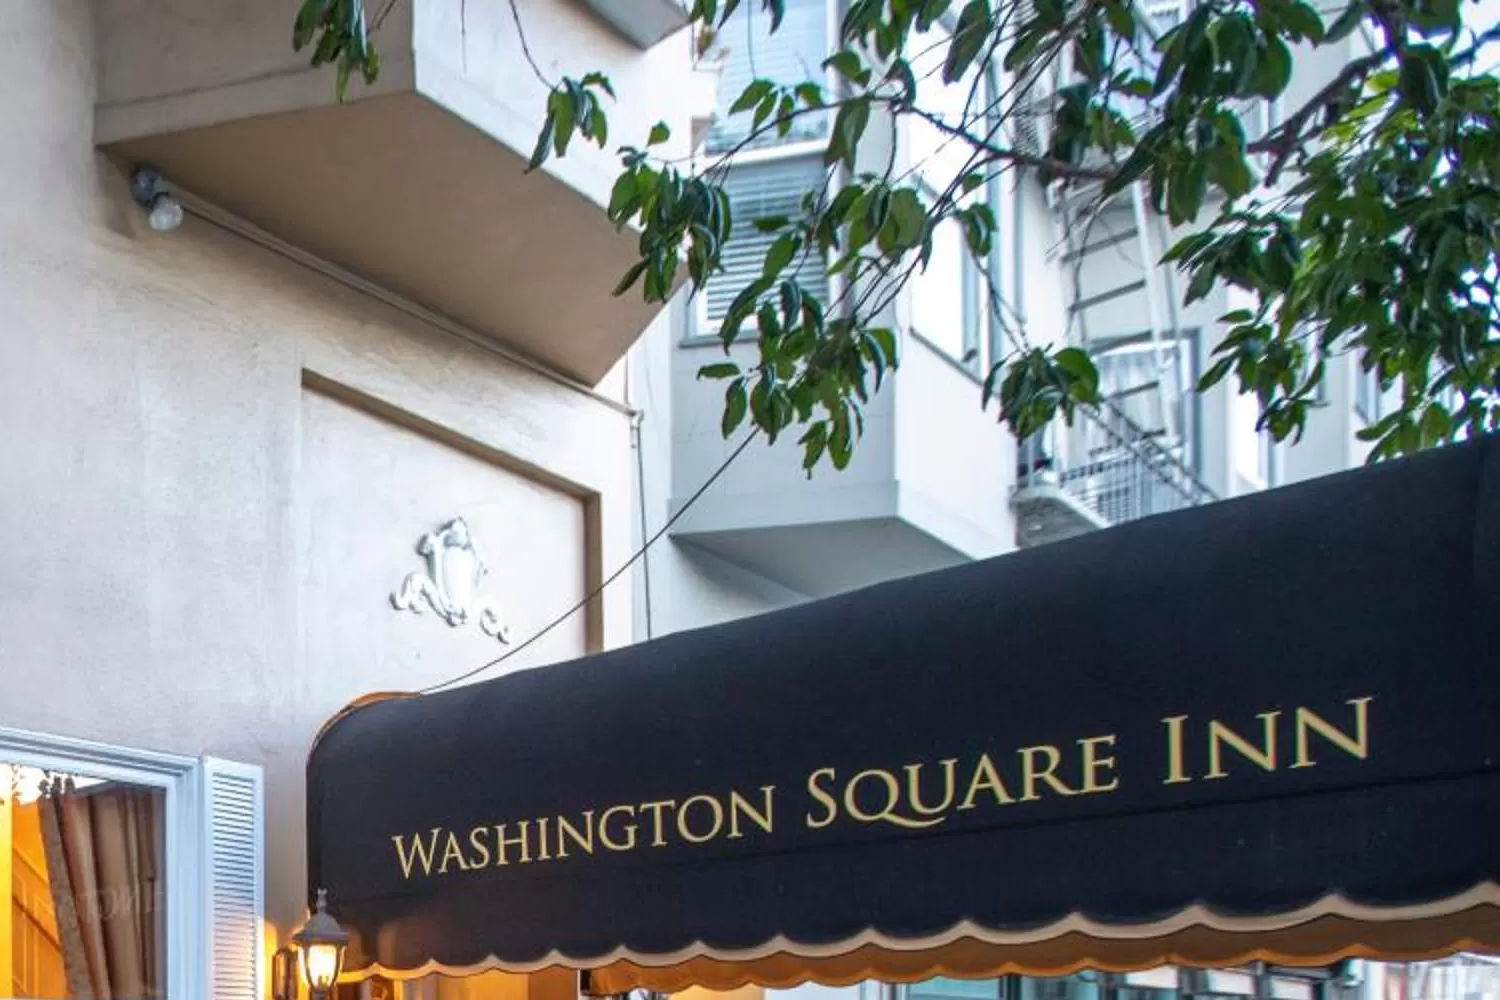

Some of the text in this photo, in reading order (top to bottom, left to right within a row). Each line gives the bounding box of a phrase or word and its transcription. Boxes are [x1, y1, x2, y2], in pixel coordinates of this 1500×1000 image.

[391, 696, 1373, 880] WASHINGTON SQUARE INN
